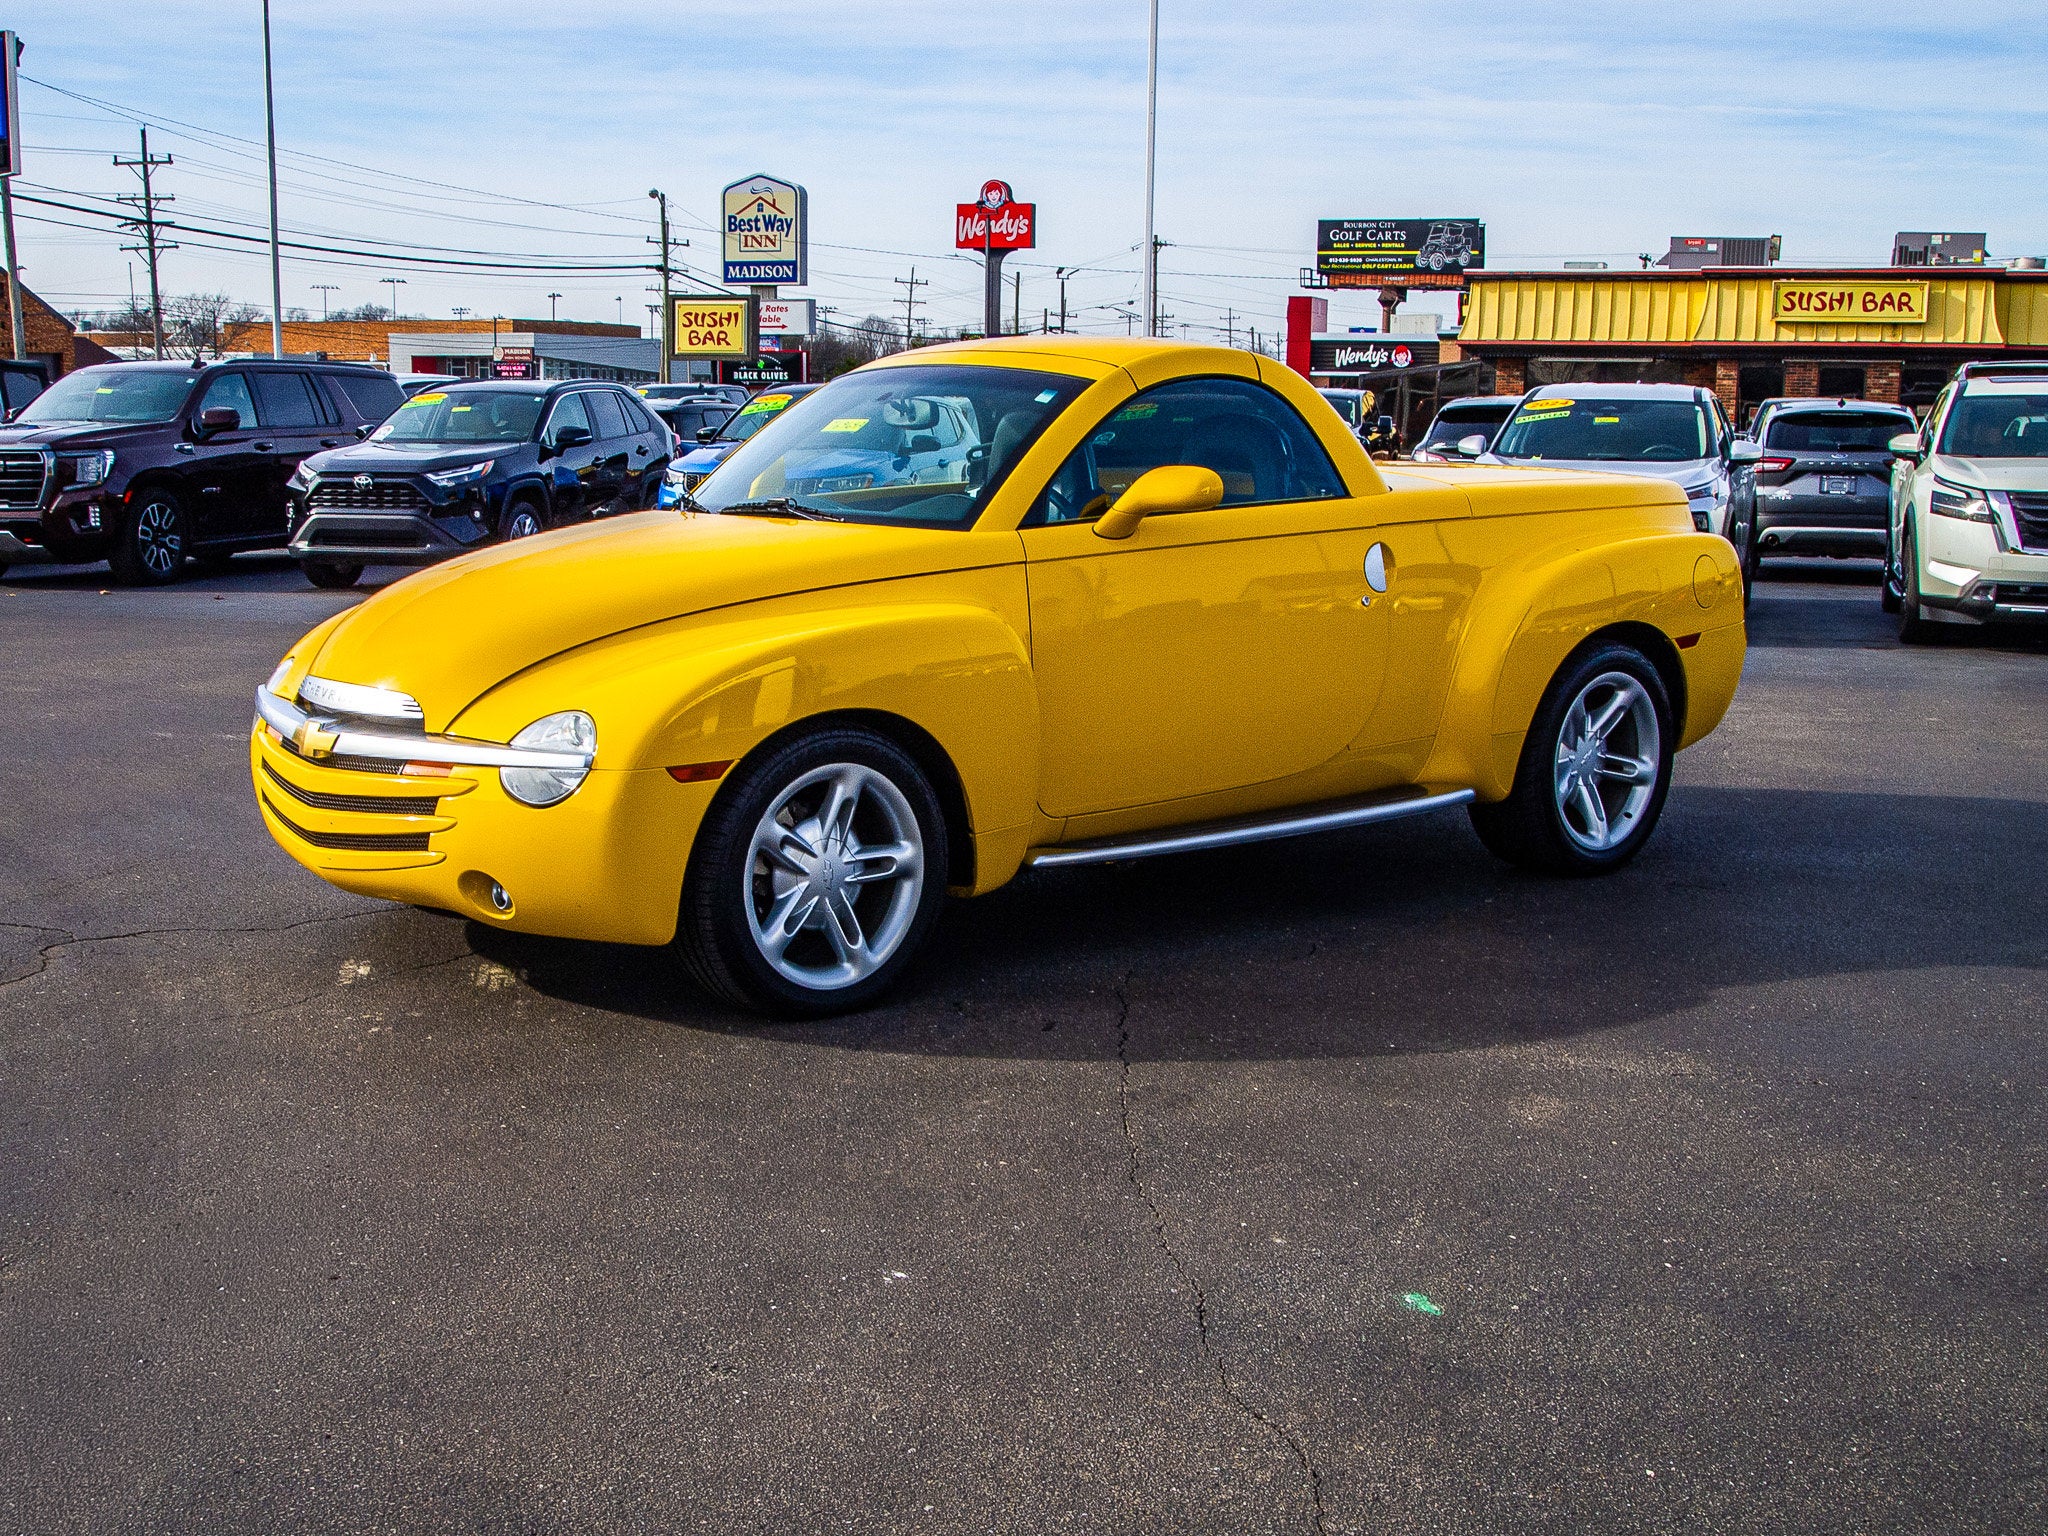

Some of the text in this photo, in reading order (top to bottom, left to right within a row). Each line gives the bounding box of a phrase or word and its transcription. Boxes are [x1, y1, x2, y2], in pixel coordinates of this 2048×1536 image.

[727, 213, 794, 238] Best Way
[958, 209, 1029, 242] Wendy's
[1343, 221, 1396, 229] BOURBON CITY
[743, 234, 777, 248] INN
[1329, 229, 1407, 241] GOLF CARTS
[727, 265, 794, 279] MADISON
[765, 304, 789, 313] Rates
[1782, 291, 1915, 312] SUSHI BAR
[682, 311, 739, 346] SUSHI BAR
[1335, 344, 1389, 368] Wendy's
[733, 371, 789, 380] BLACK OLIVES
